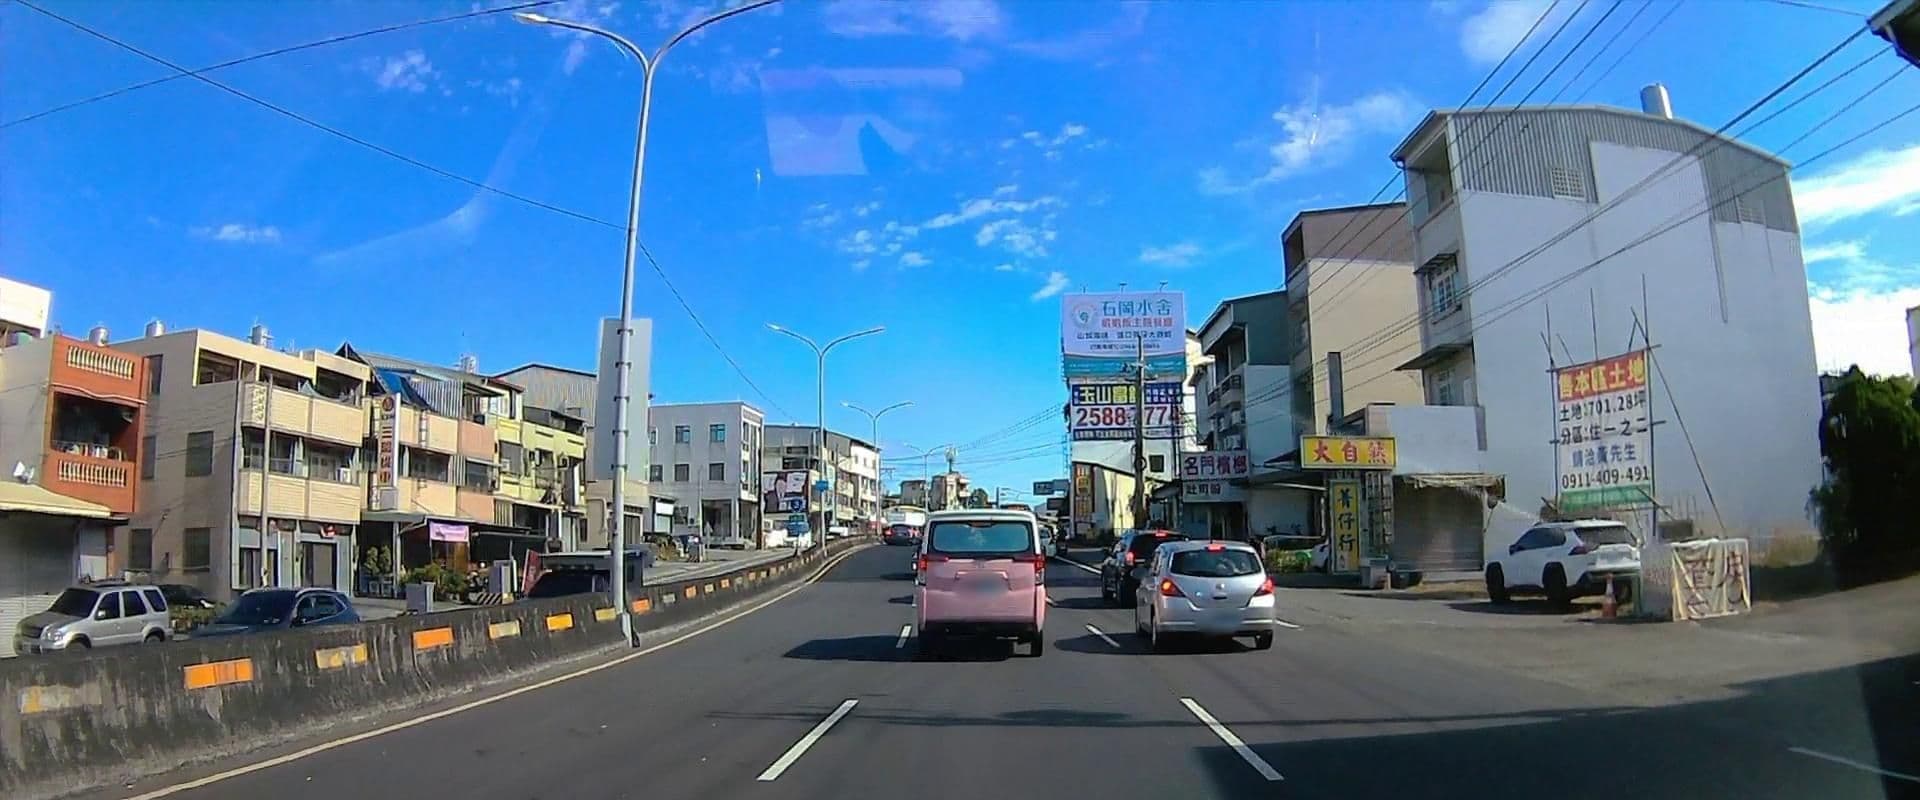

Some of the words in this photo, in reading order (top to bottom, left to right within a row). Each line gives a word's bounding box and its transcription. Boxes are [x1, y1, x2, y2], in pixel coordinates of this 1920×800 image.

[1313, 440, 1387, 464] 大自然
[1184, 455, 1247, 475] 名門檳榔
